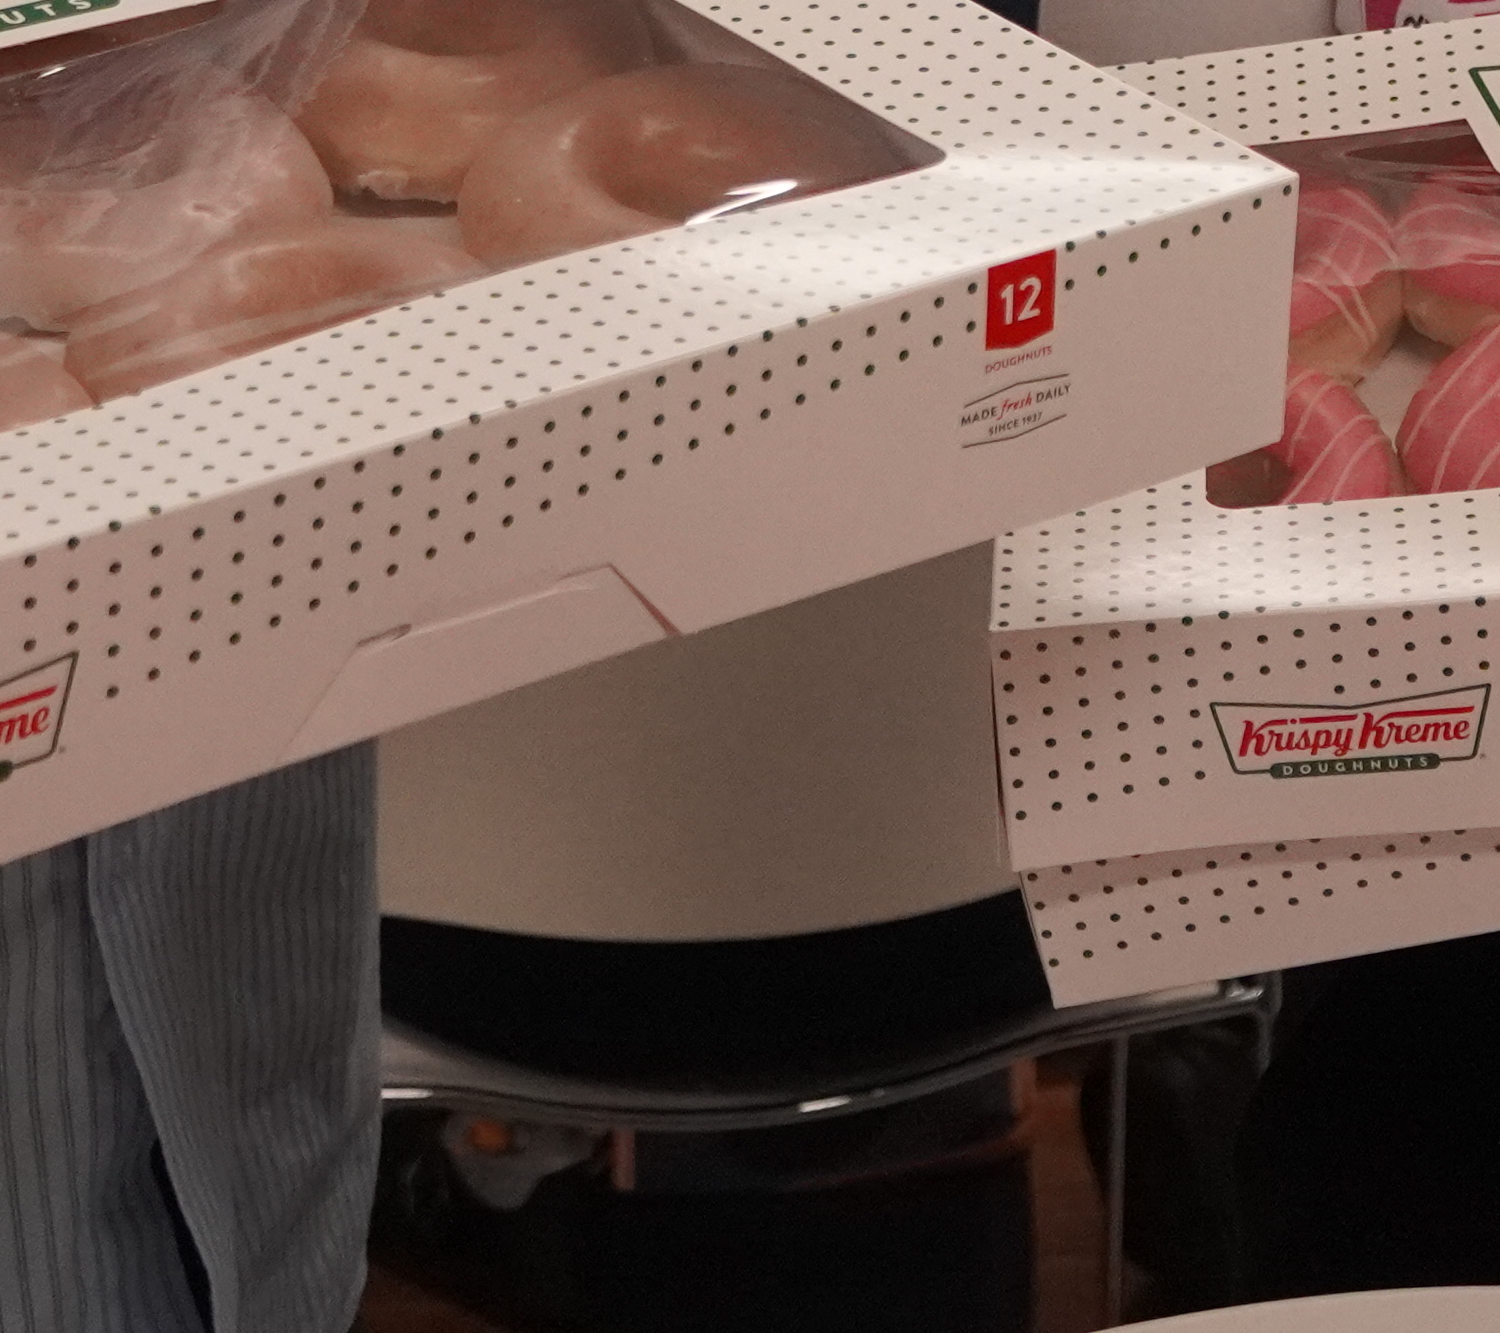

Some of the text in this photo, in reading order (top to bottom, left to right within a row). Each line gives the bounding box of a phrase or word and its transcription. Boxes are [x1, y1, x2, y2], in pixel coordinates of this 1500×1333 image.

[1001, 276, 1042, 326] 12
[985, 345, 1053, 375] DOUGHNUTS
[960, 382, 1072, 428] MADE fresh DAILY
[988, 411, 1043, 437] SINCE 1937
[1238, 706, 1475, 757] Krispy Kreme
[1282, 756, 1429, 777] DOUGHNUTS
